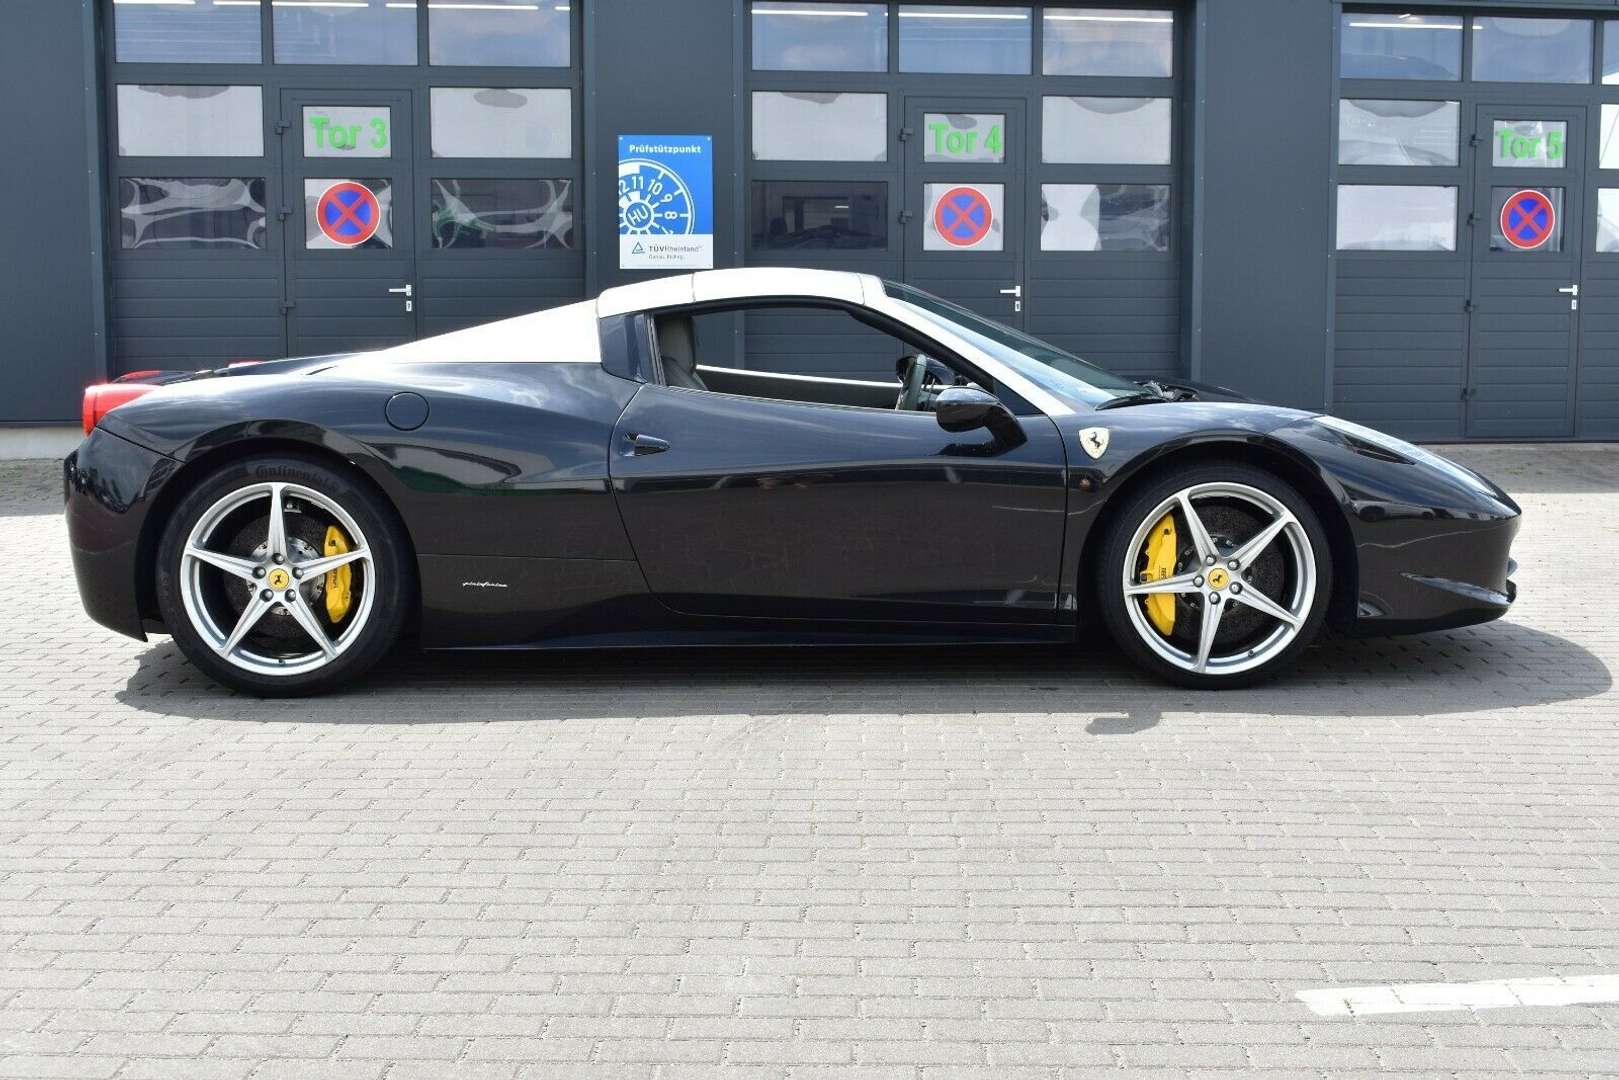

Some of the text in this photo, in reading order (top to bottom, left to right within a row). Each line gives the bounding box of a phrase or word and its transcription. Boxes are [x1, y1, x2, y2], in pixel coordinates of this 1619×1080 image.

[309, 116, 388, 151] Tor 3
[928, 123, 1003, 155] Tor 4
[629, 143, 702, 154] Prüfstützpunkt
[1496, 127, 1565, 160] Tor 5
[618, 180, 630, 196] 2
[631, 176, 644, 190] 11
[648, 178, 663, 196] 10
[660, 194, 673, 203] 9
[627, 205, 649, 226] HU
[664, 211, 678, 220] 8
